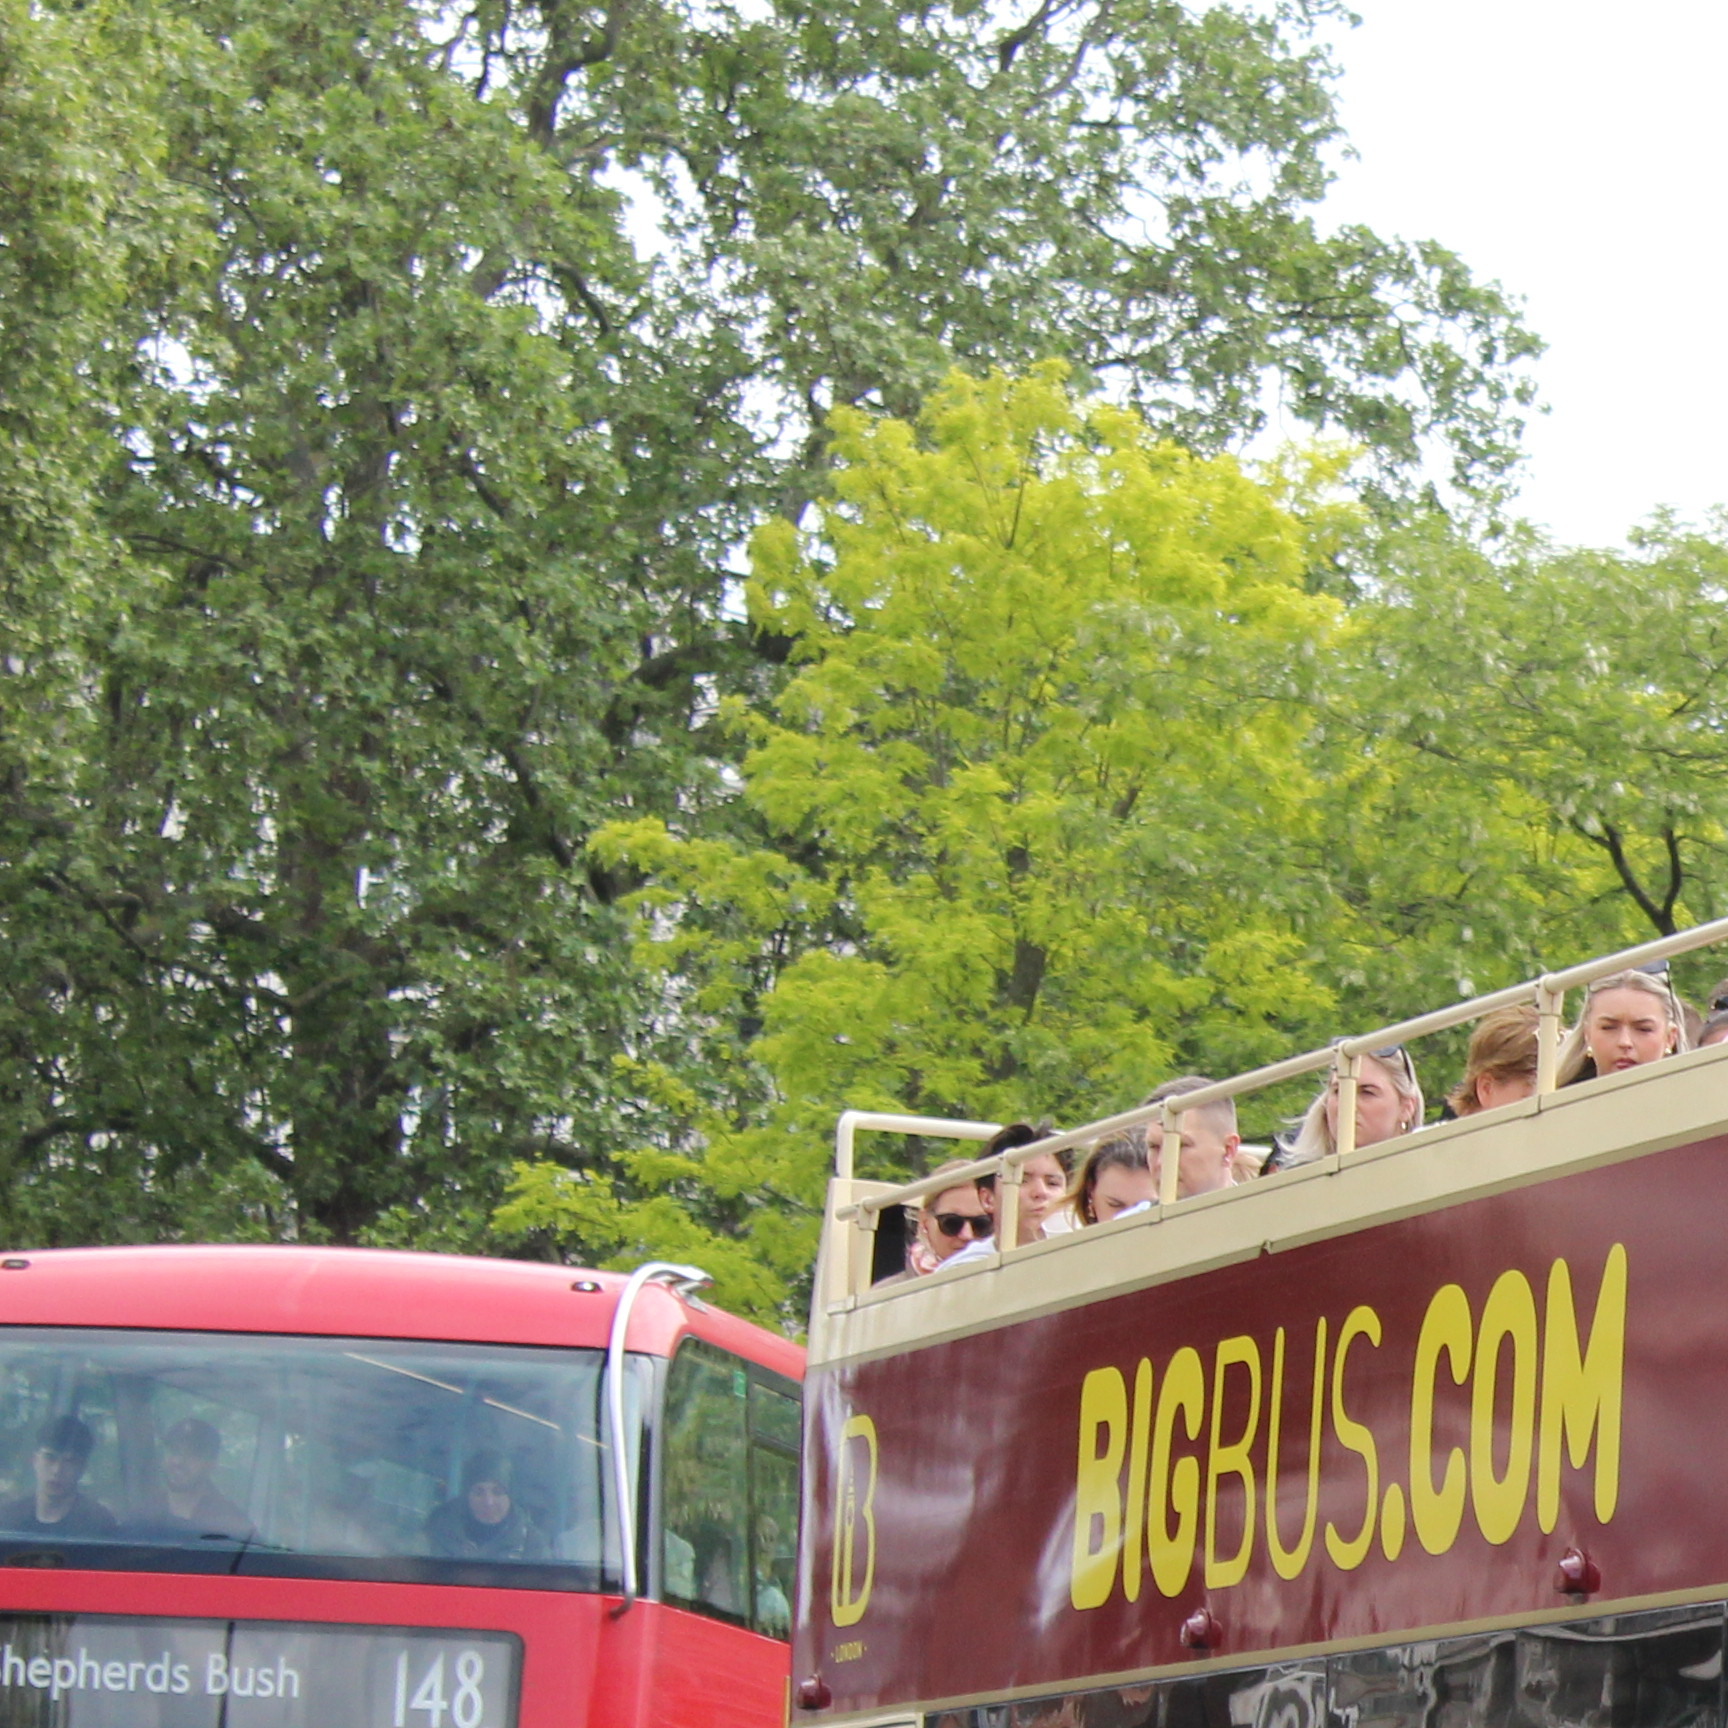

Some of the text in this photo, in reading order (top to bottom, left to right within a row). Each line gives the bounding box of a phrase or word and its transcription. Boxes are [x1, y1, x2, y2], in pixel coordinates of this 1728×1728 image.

[1070, 1242, 1628, 1611] BIGBUS.COM
[0, 1644, 191, 1701] hepherds
[206, 1653, 300, 1699] Bush
